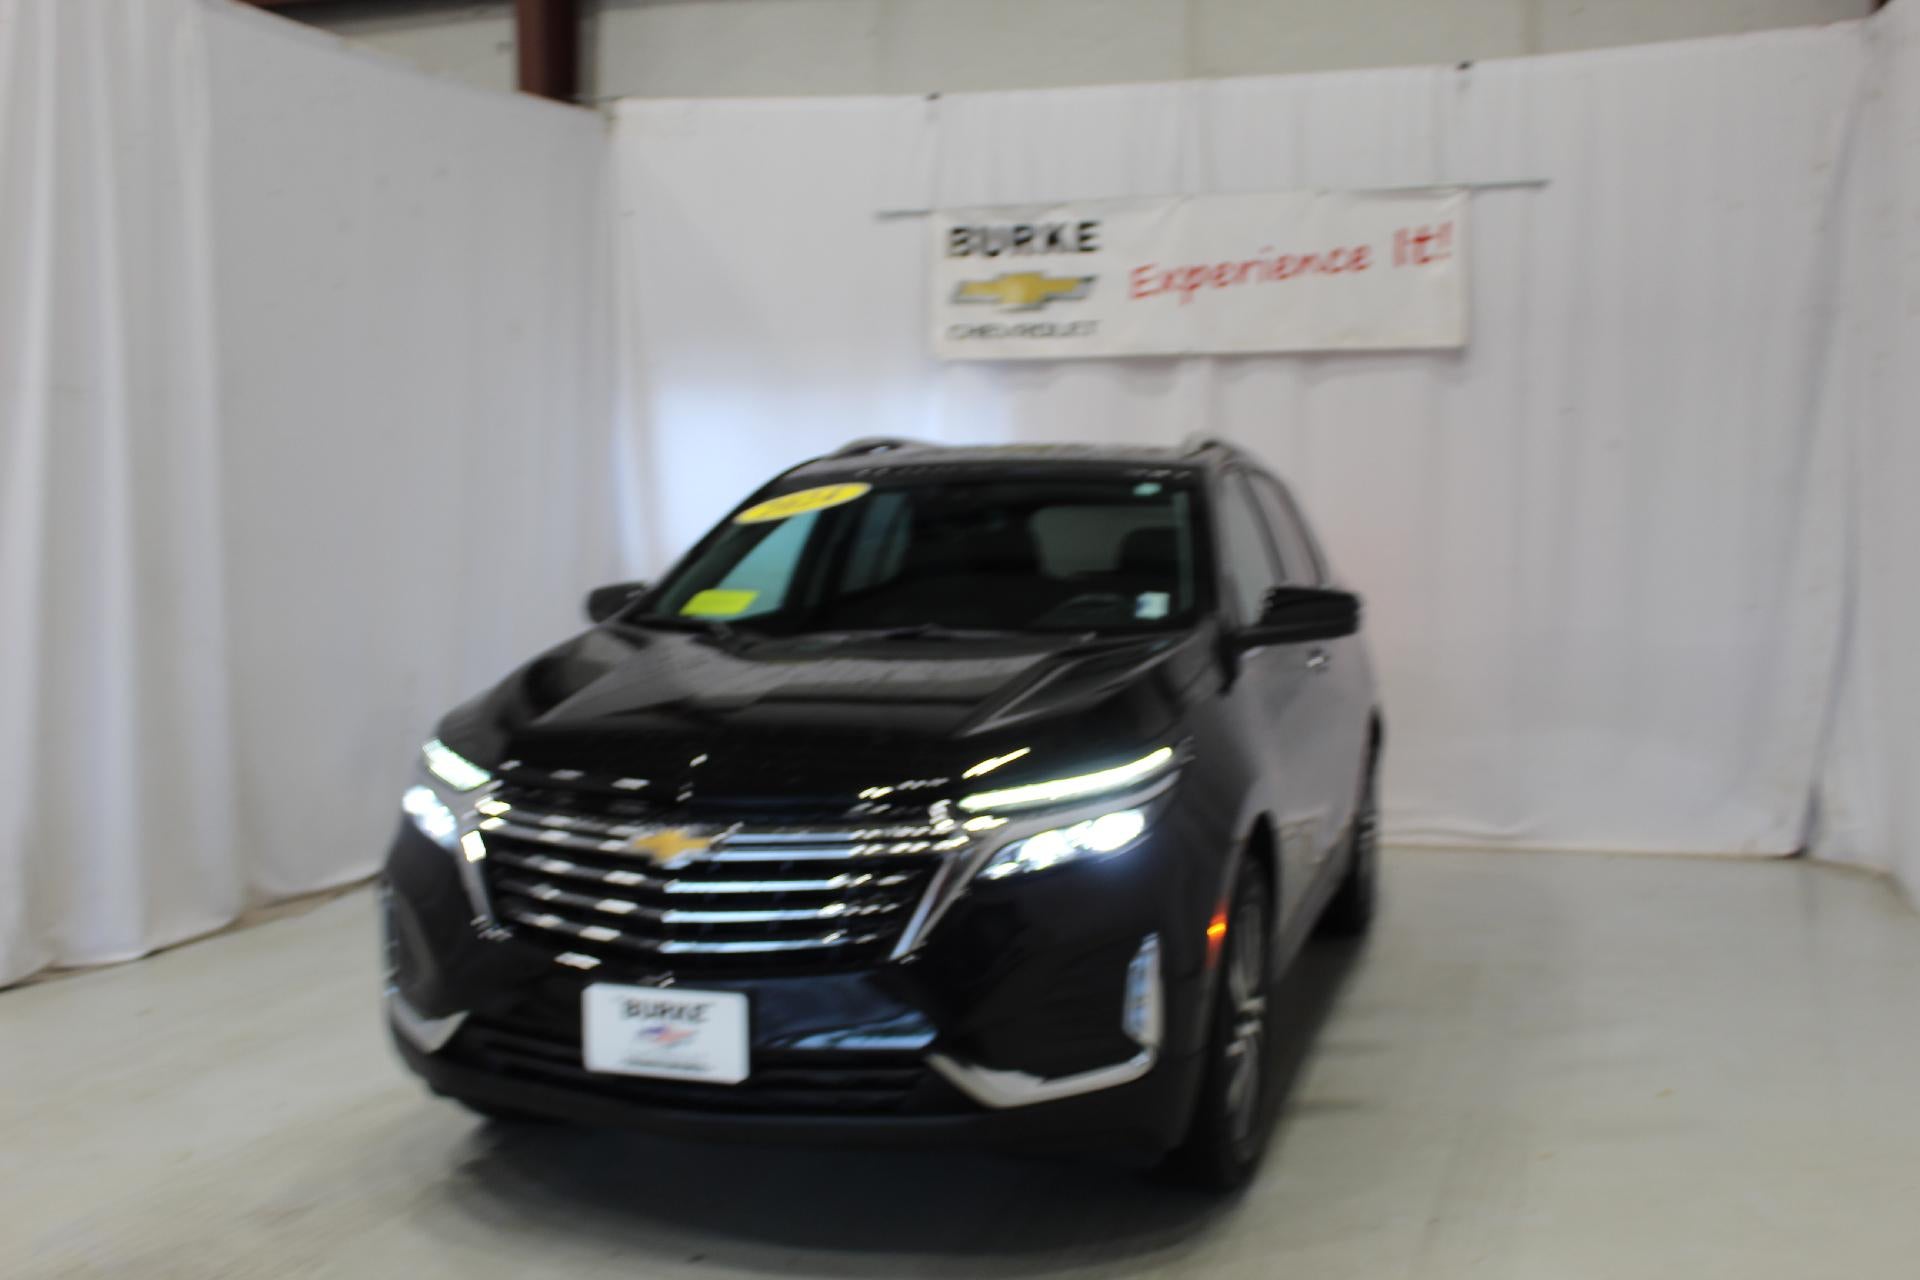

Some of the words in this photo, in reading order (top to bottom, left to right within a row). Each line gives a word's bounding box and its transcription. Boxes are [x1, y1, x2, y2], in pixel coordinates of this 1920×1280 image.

[947, 220, 1102, 258] BURKE
[1128, 245, 1370, 305] Experience
[1393, 220, 1454, 269] It!
